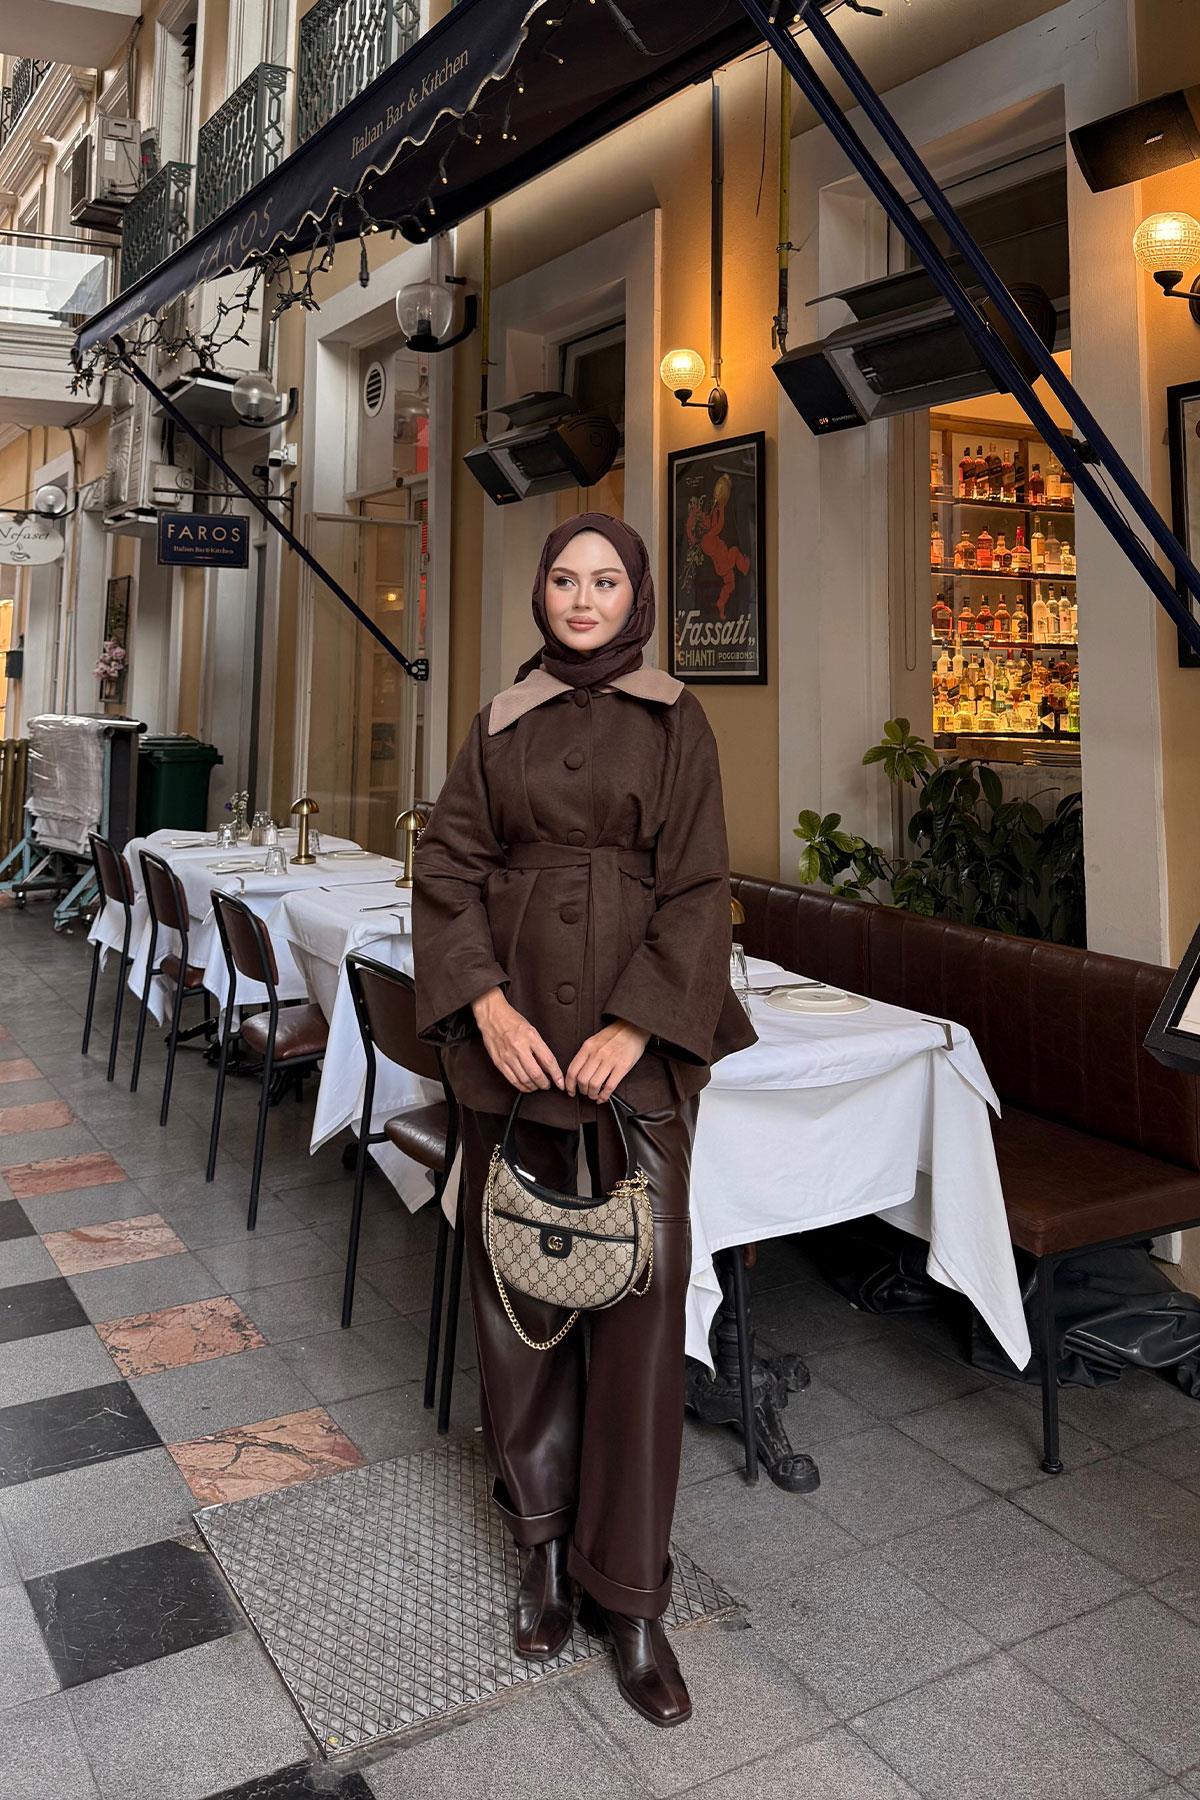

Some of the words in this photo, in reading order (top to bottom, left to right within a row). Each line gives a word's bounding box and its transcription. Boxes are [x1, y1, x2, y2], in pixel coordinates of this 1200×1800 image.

[386, 102, 406, 130] Bar
[407, 87, 418, 112] &
[195, 197, 273, 281] FAROS
[167, 523, 241, 542] FAROS
[678, 649, 716, 666] CHIANTI
